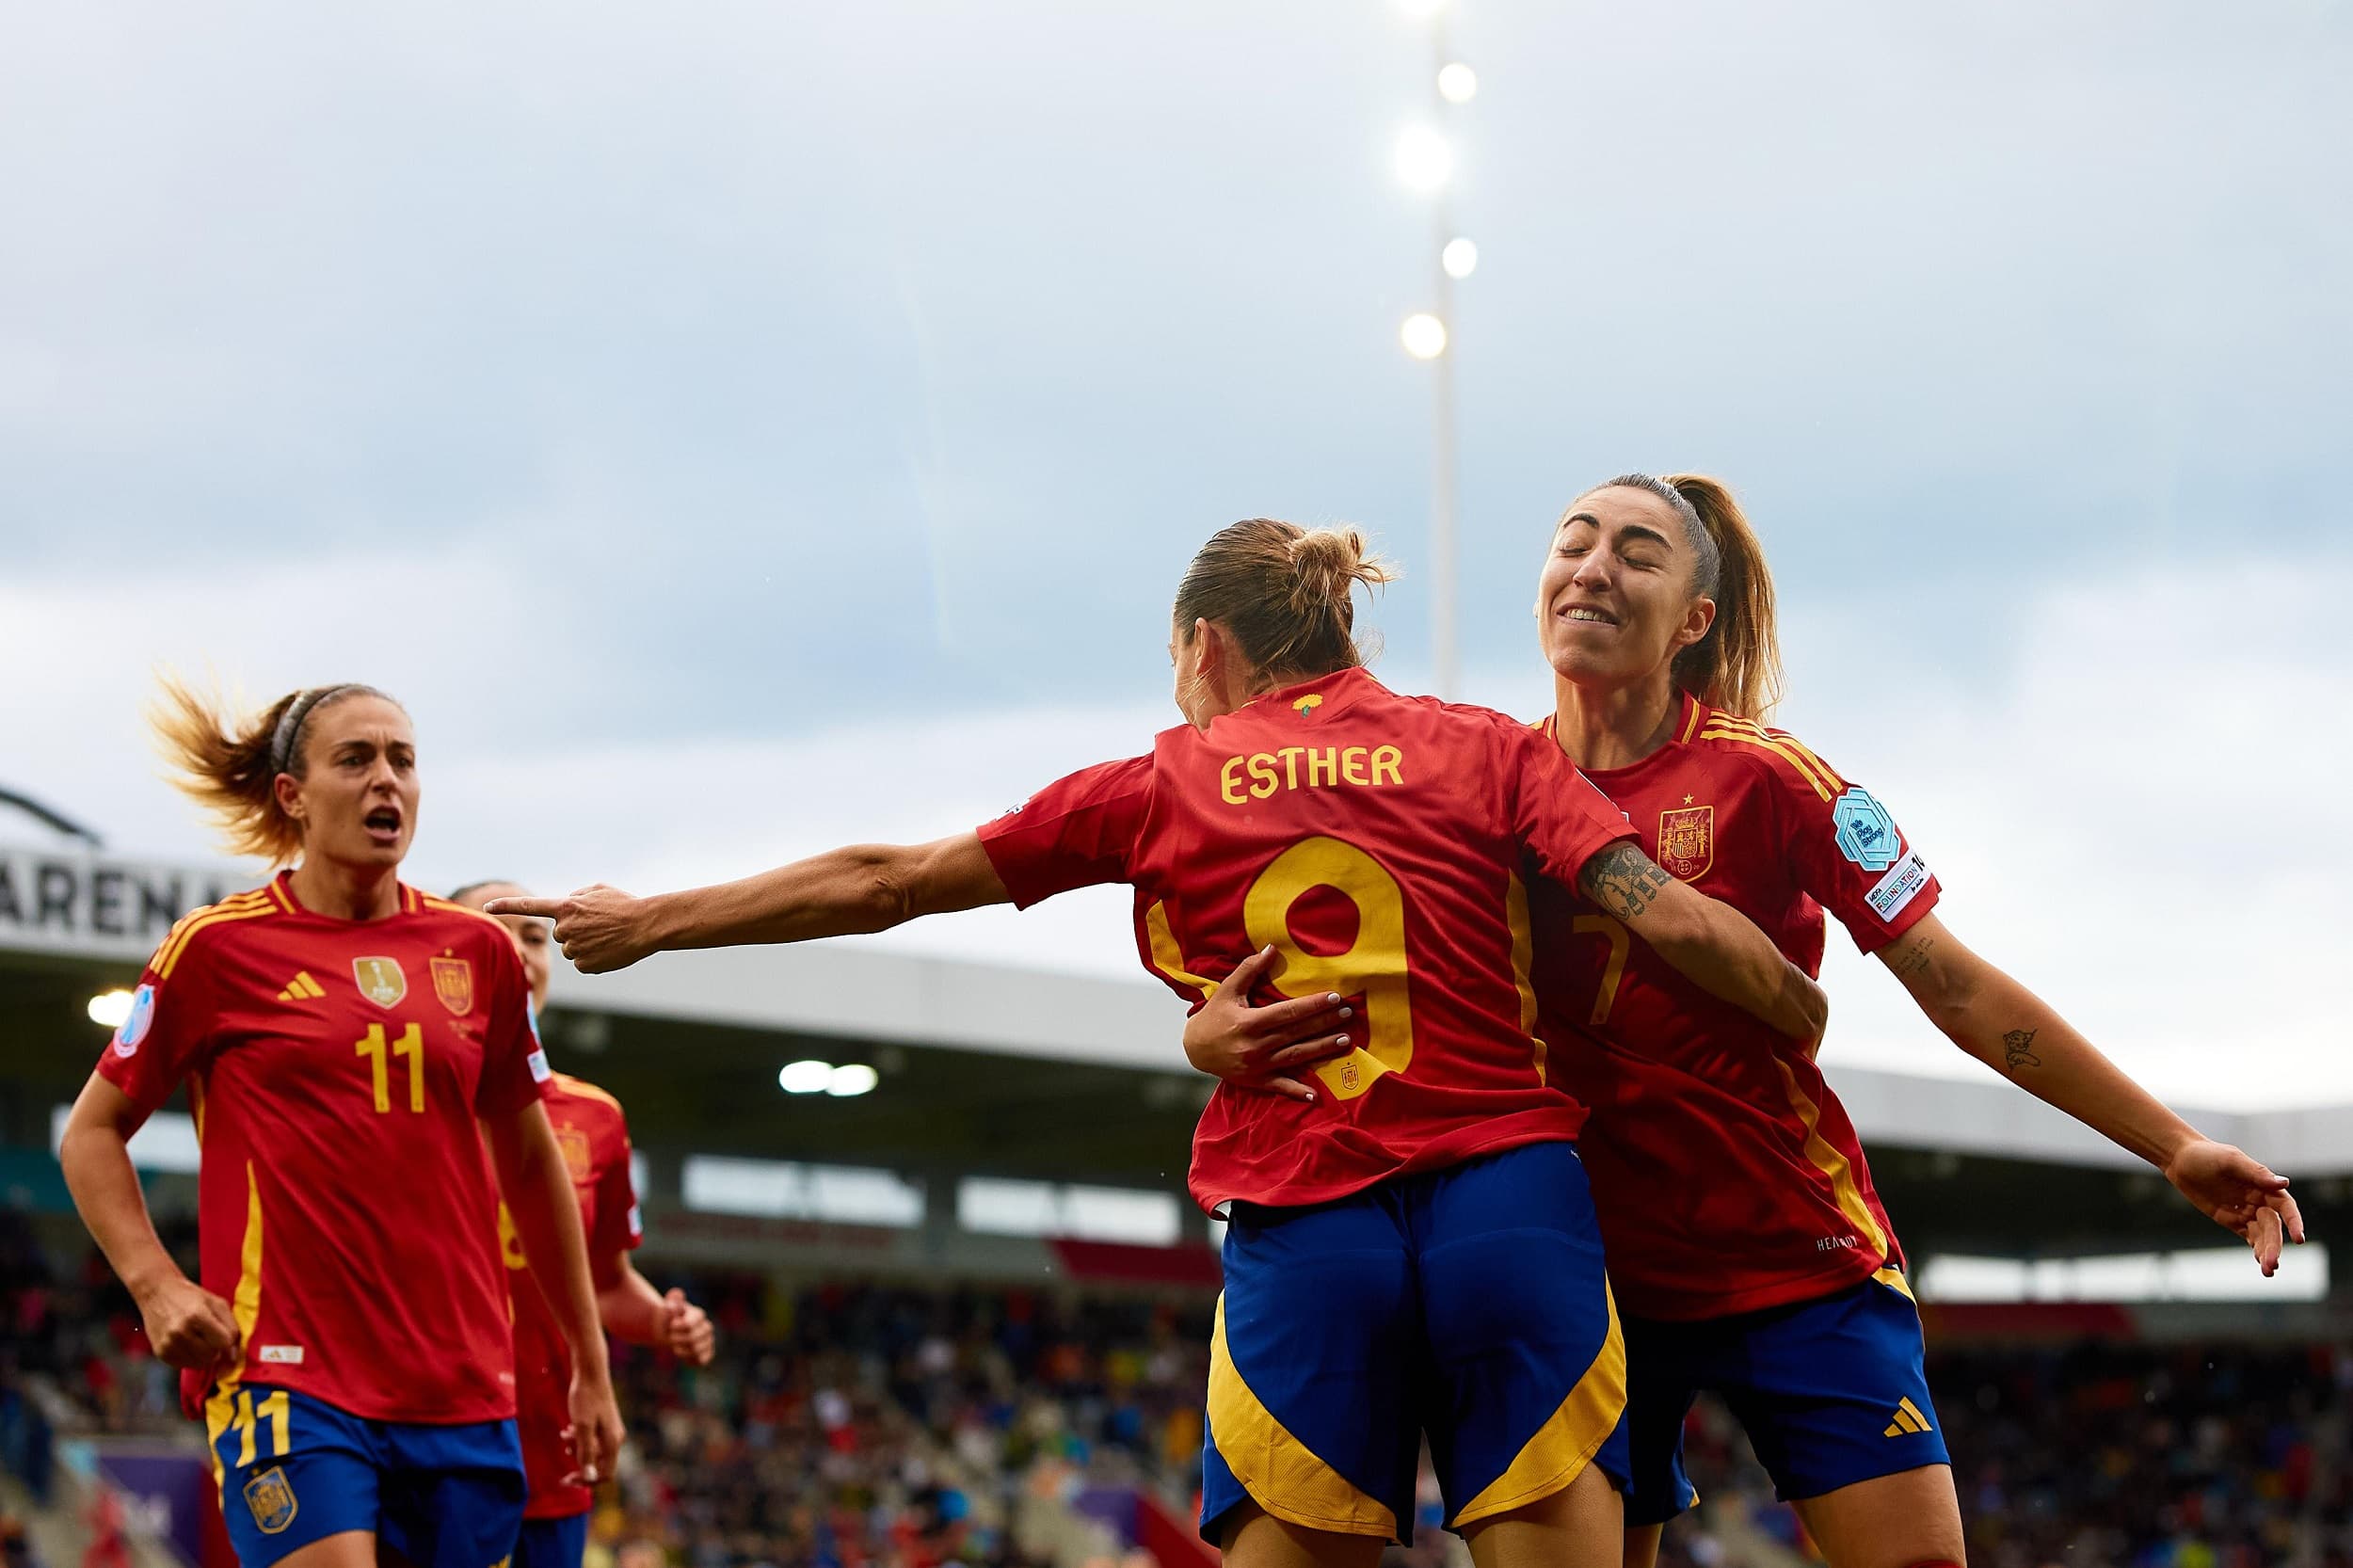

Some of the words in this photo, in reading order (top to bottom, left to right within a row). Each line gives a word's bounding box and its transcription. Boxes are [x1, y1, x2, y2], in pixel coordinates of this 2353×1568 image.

[1222, 745, 1403, 805] ESTHER
[1857, 824, 1873, 840] Play
[1862, 827, 1884, 847] Strong
[1868, 888, 1882, 903] UEFA
[1876, 866, 1918, 912] FOUNDATION
[1243, 836, 1414, 1100] 9
[1573, 915, 1630, 1025] 7
[355, 1022, 424, 1112] 11
[232, 1389, 291, 1468] 11
